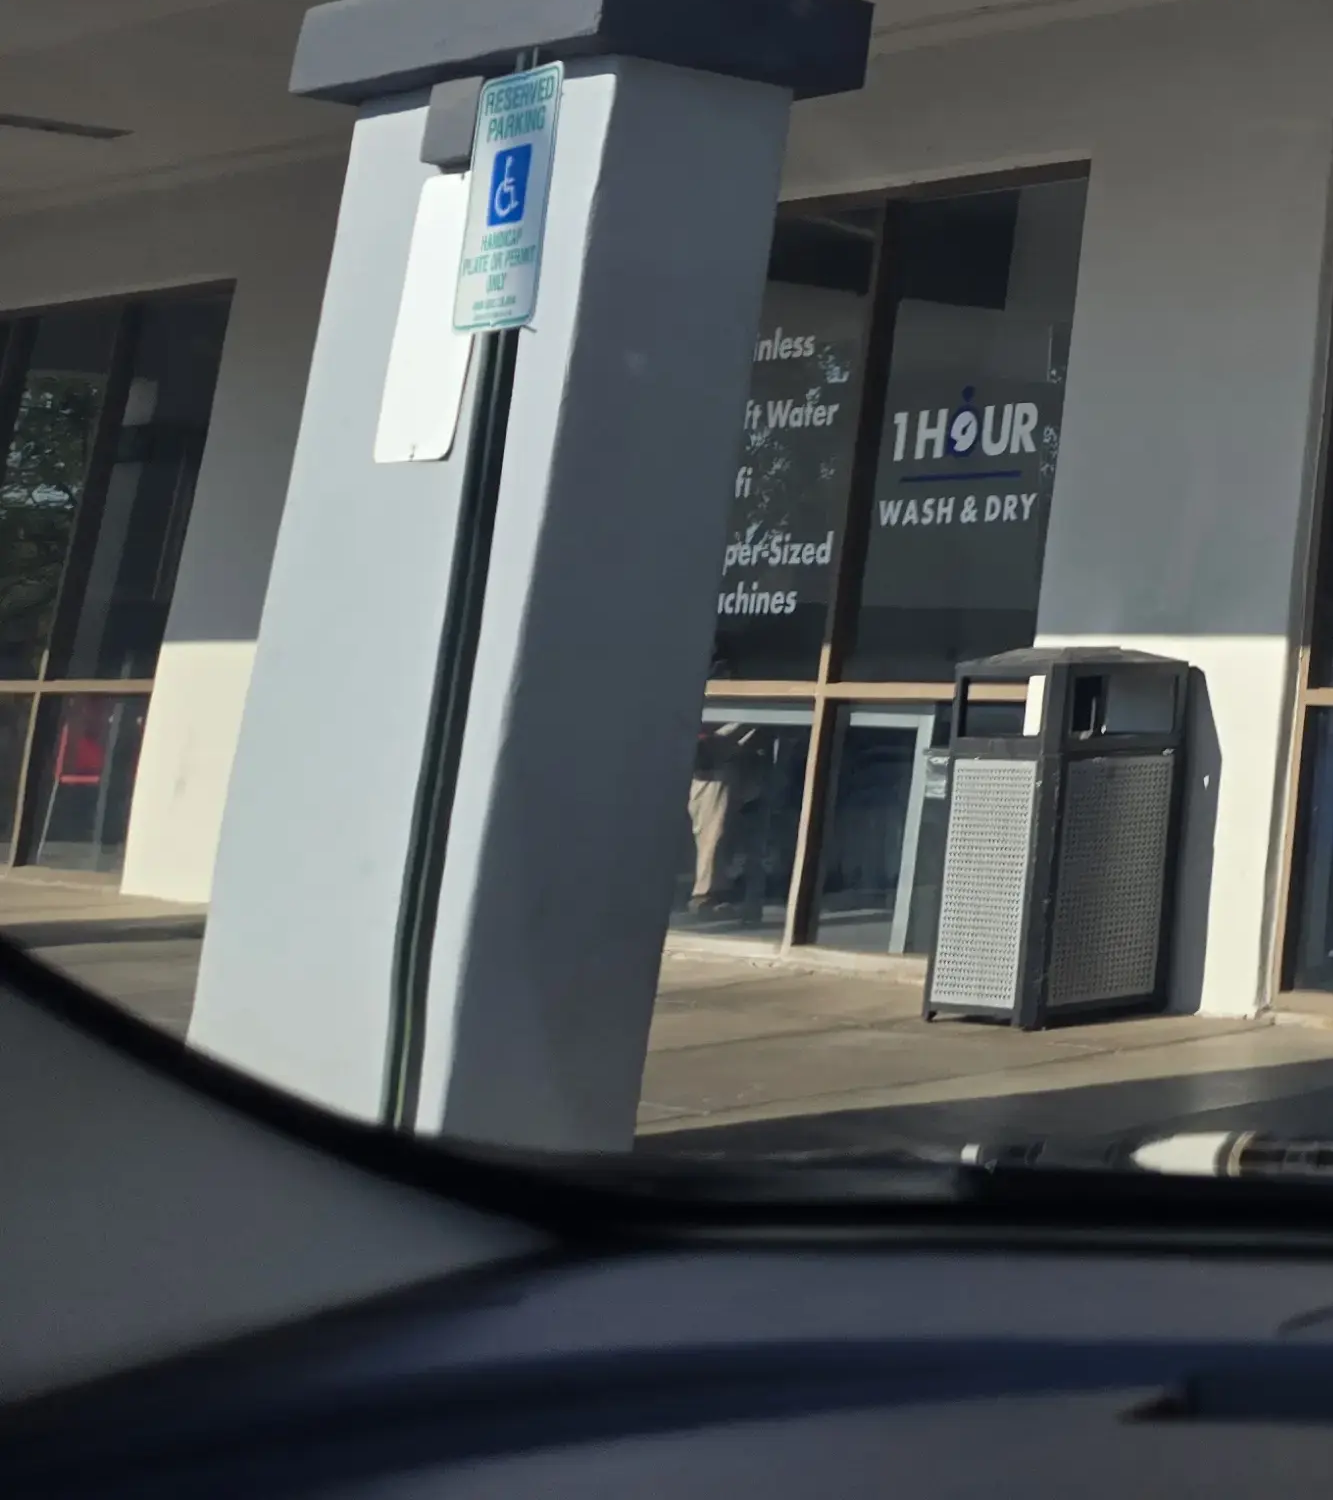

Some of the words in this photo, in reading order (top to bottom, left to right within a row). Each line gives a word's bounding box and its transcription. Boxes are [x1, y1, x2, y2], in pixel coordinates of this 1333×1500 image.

[485, 76, 555, 116] RESERVED
[486, 105, 546, 143] PARKING
[767, 399, 840, 428] Water
[893, 412, 909, 462] 1
[914, 402, 1039, 460] HOUR
[879, 496, 955, 527] WASH
[960, 494, 979, 524] &
[984, 492, 1038, 522] DRY
[722, 530, 835, 576] per-Sized
